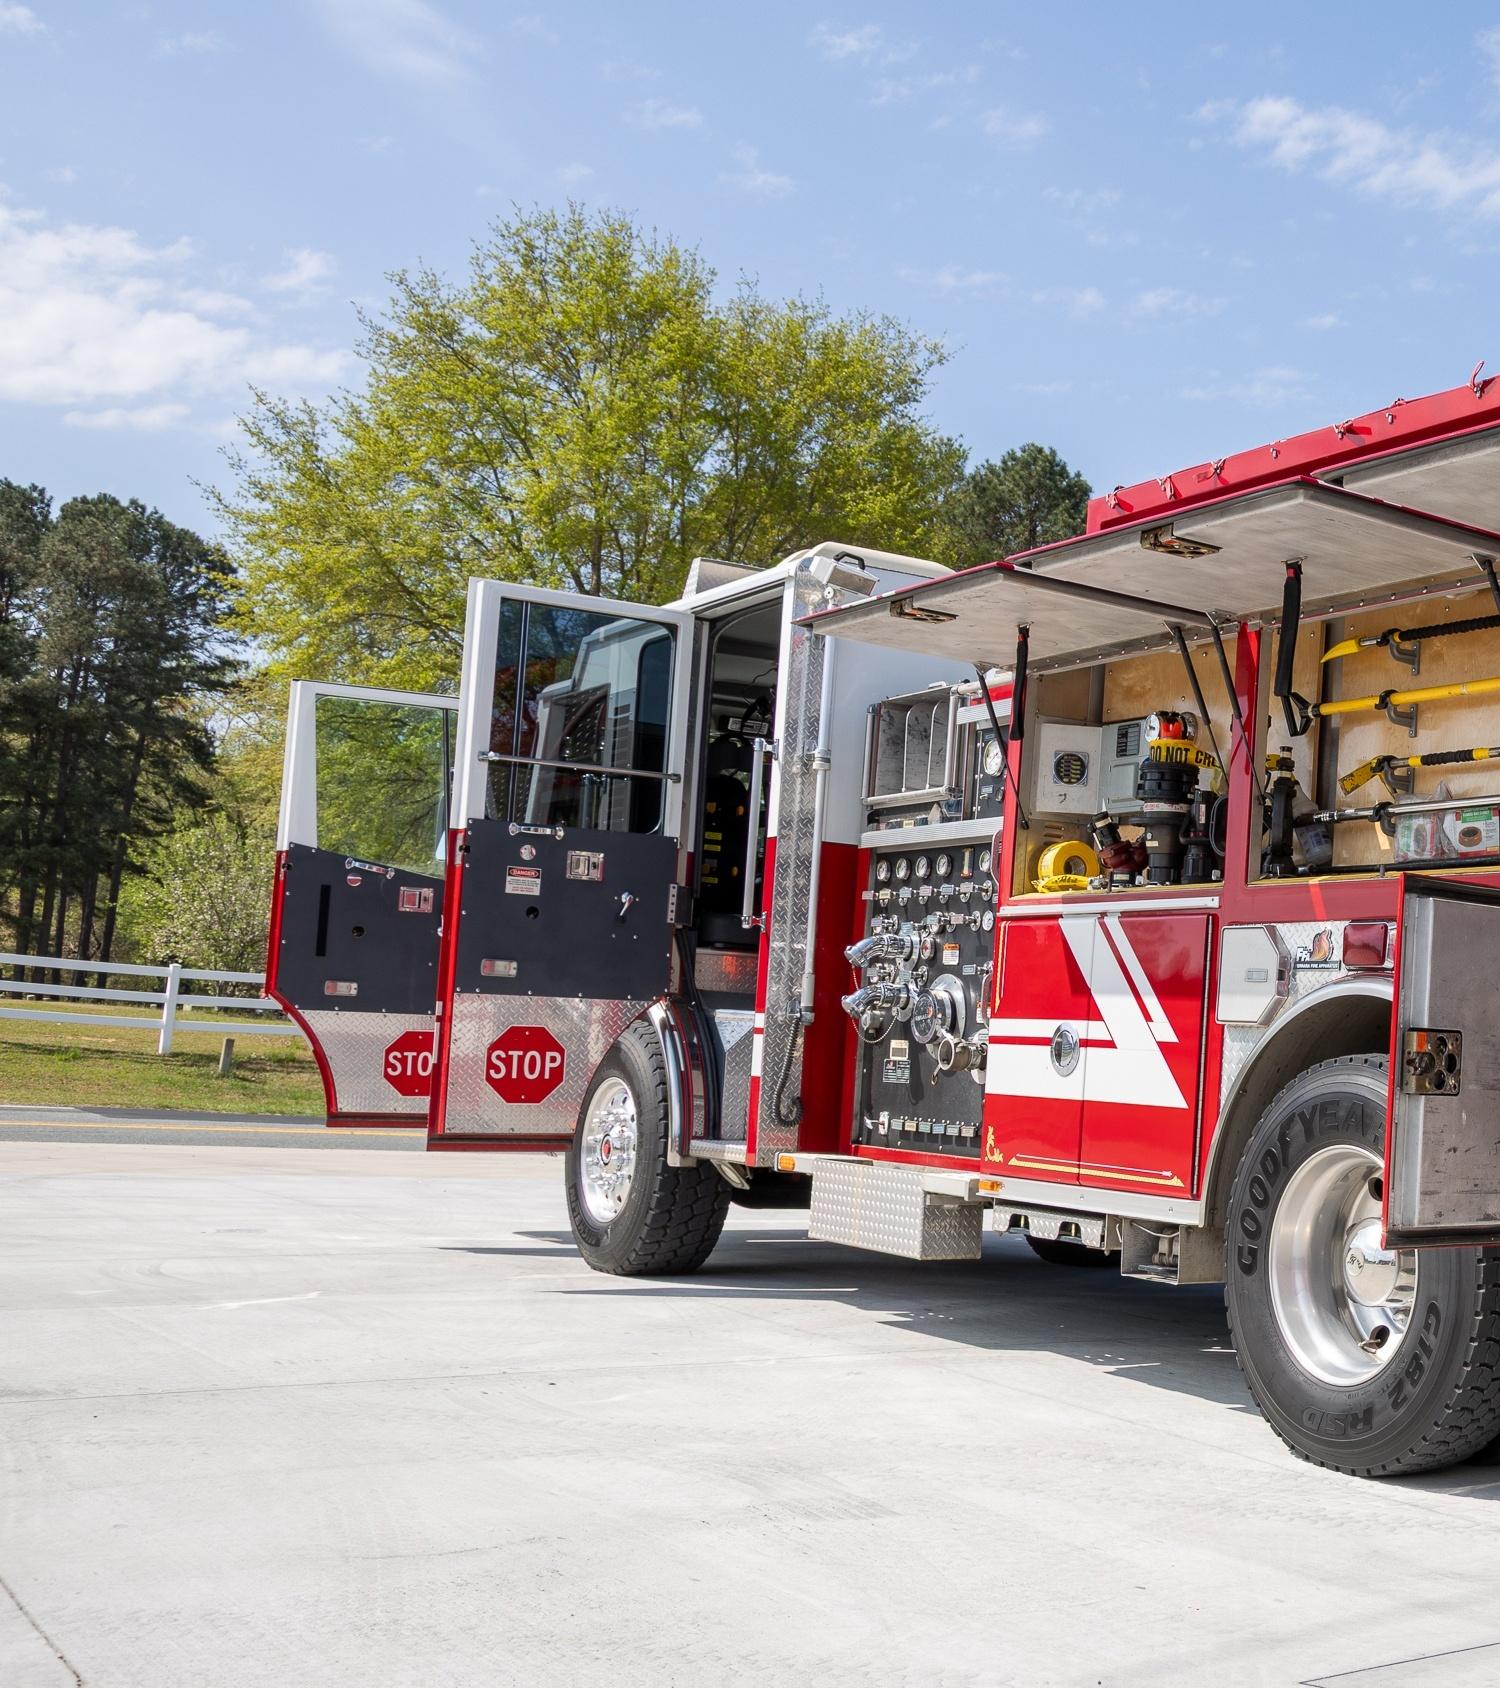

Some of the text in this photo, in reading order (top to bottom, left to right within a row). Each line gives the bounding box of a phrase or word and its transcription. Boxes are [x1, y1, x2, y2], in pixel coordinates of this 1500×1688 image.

[1166, 745, 1191, 765] NOT
[512, 868, 536, 877] DANGER
[386, 1051, 433, 1077] STO
[489, 1049, 562, 1080] STOP
